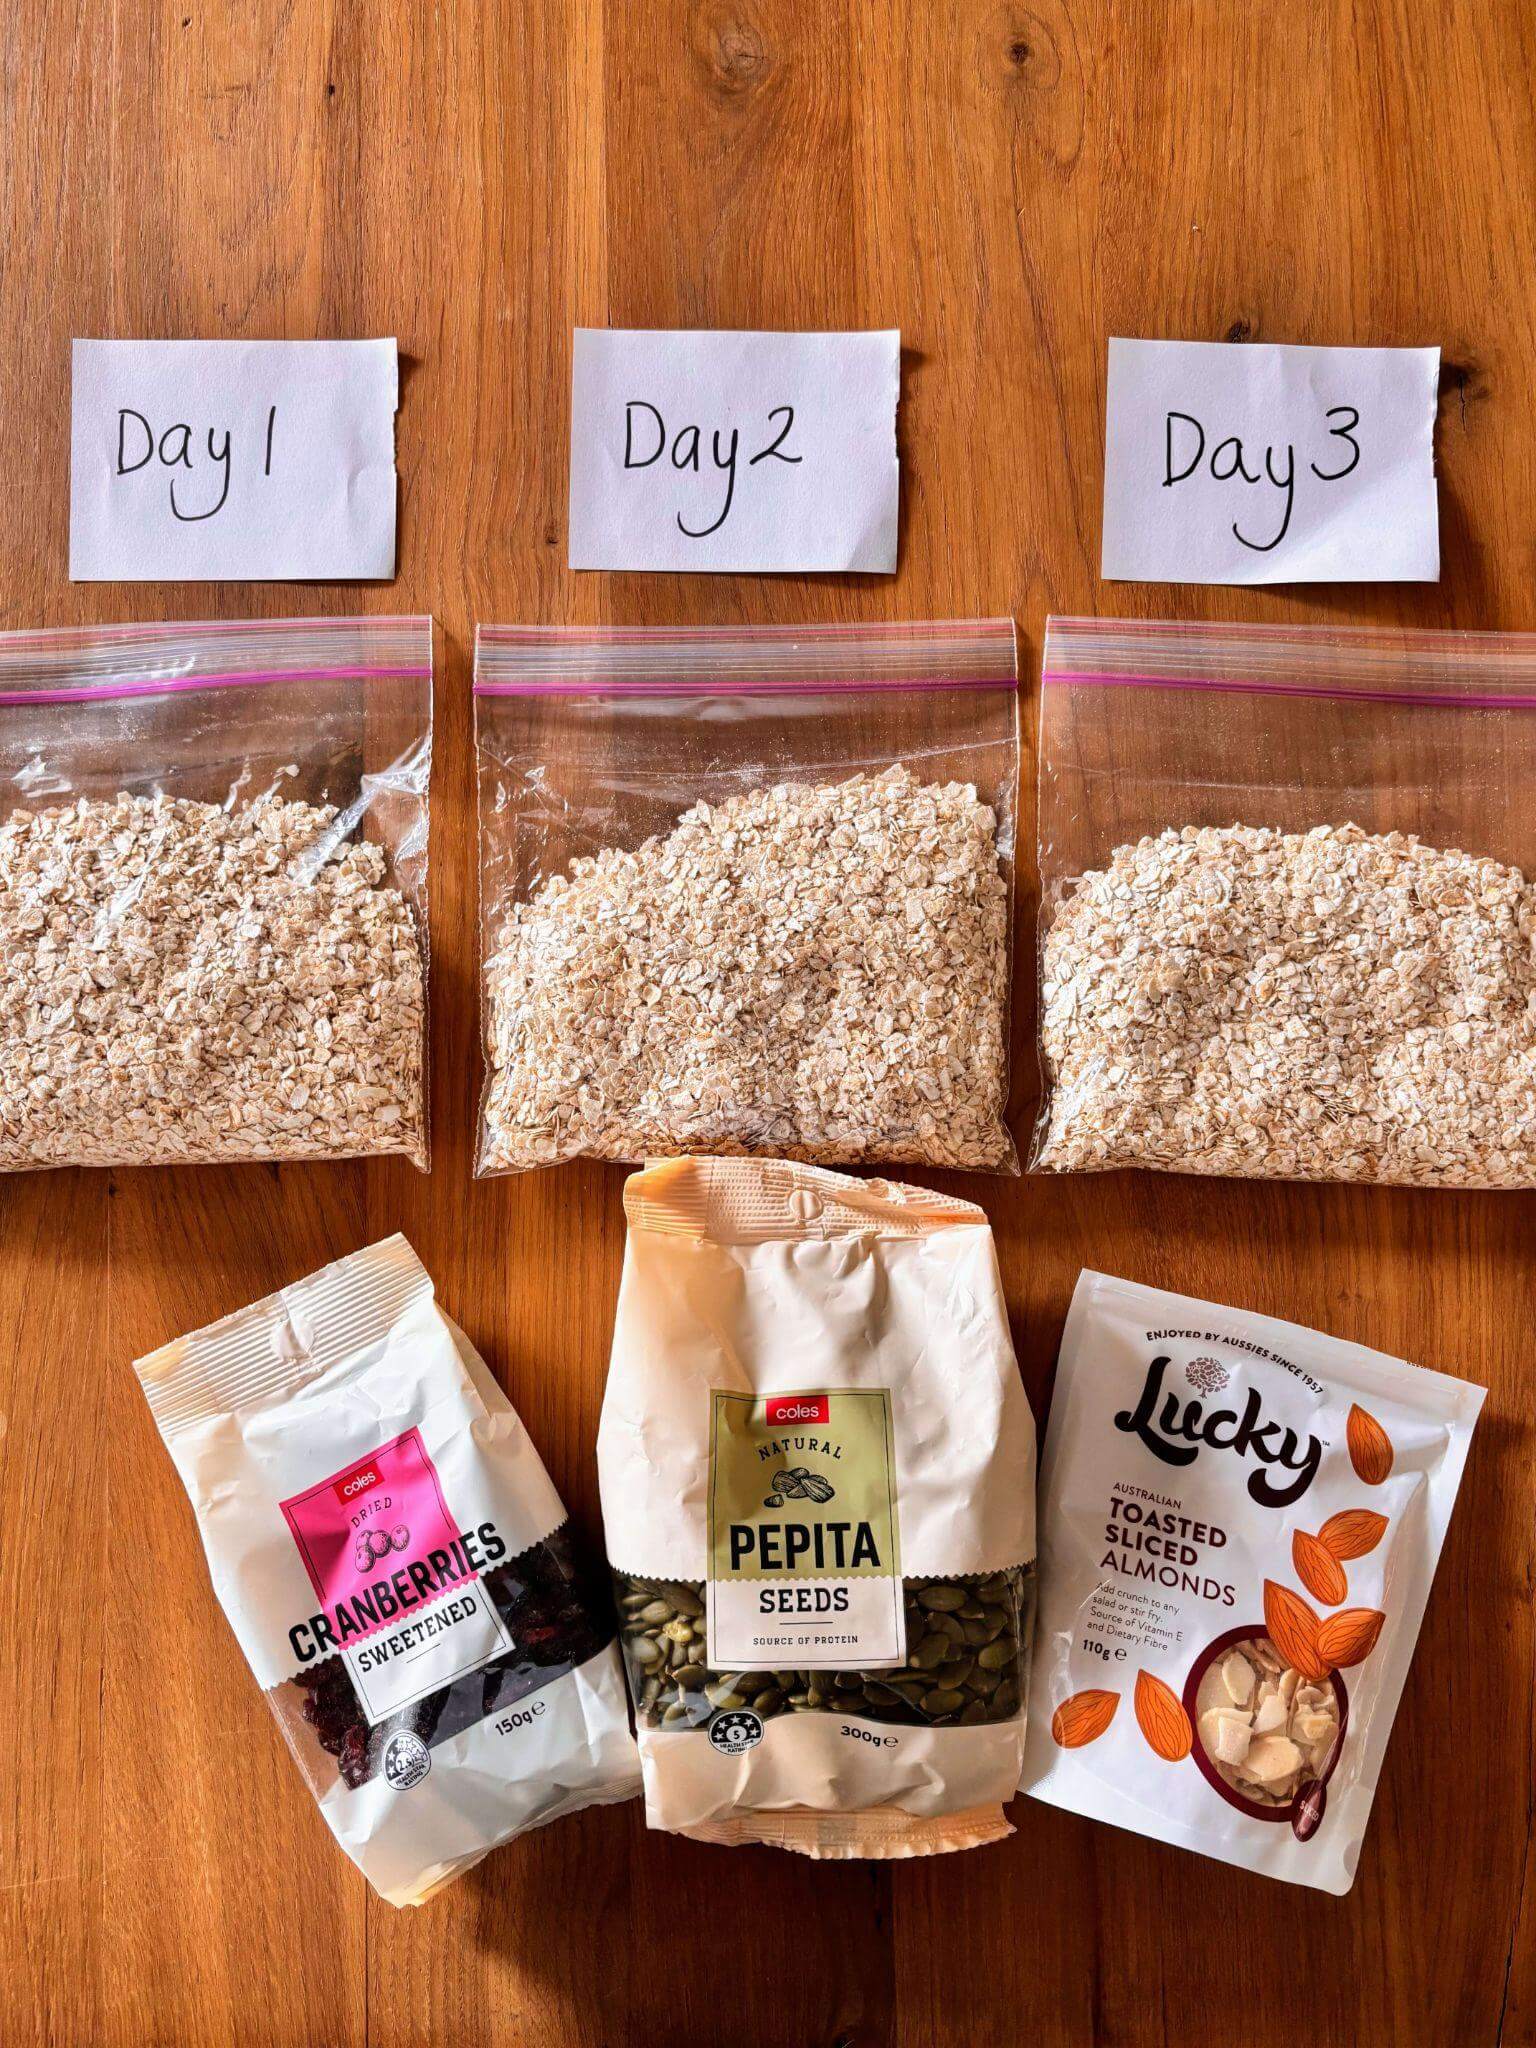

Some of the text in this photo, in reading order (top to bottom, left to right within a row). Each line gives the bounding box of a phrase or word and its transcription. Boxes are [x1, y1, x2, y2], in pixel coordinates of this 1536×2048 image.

[117, 409, 231, 521] Day
[624, 401, 803, 538] Day 2
[1162, 406, 1360, 552] Day 3
[1146, 1329, 1324, 1395] ENJOYED BY AUSSIES SINCE 1957
[775, 1403, 820, 1420] coles
[1114, 1356, 1322, 1508] Lucky
[757, 1437, 842, 1461] NATURAL
[342, 1470, 377, 1497] coles
[1113, 1482, 1182, 1509] AUSTRALIAN
[351, 1496, 393, 1528] DRIED
[1110, 1497, 1227, 1548] TOASTED
[729, 1521, 882, 1571] PEPITA
[1104, 1524, 1198, 1566] SLICED
[288, 1522, 507, 1663] CRANBERRIES
[1100, 1549, 1236, 1607] ALMONDS
[759, 1587, 850, 1614] SEEDS
[1092, 1595, 1164, 1624] salad or stir fry.
[1095, 1582, 1180, 1615] Add crunch to any
[358, 1595, 478, 1673] SWEETENED
[1086, 1620, 1168, 1651] and Dietary Fibre
[1090, 1606, 1184, 1641] Source of Vitamin E
[753, 1635, 859, 1646] SOURCE OF PROTEIN
[1082, 1639, 1110, 1661] 110g
[494, 1710, 534, 1737] 150g
[733, 1730, 741, 1740] 5
[840, 1725, 881, 1748] 300g
